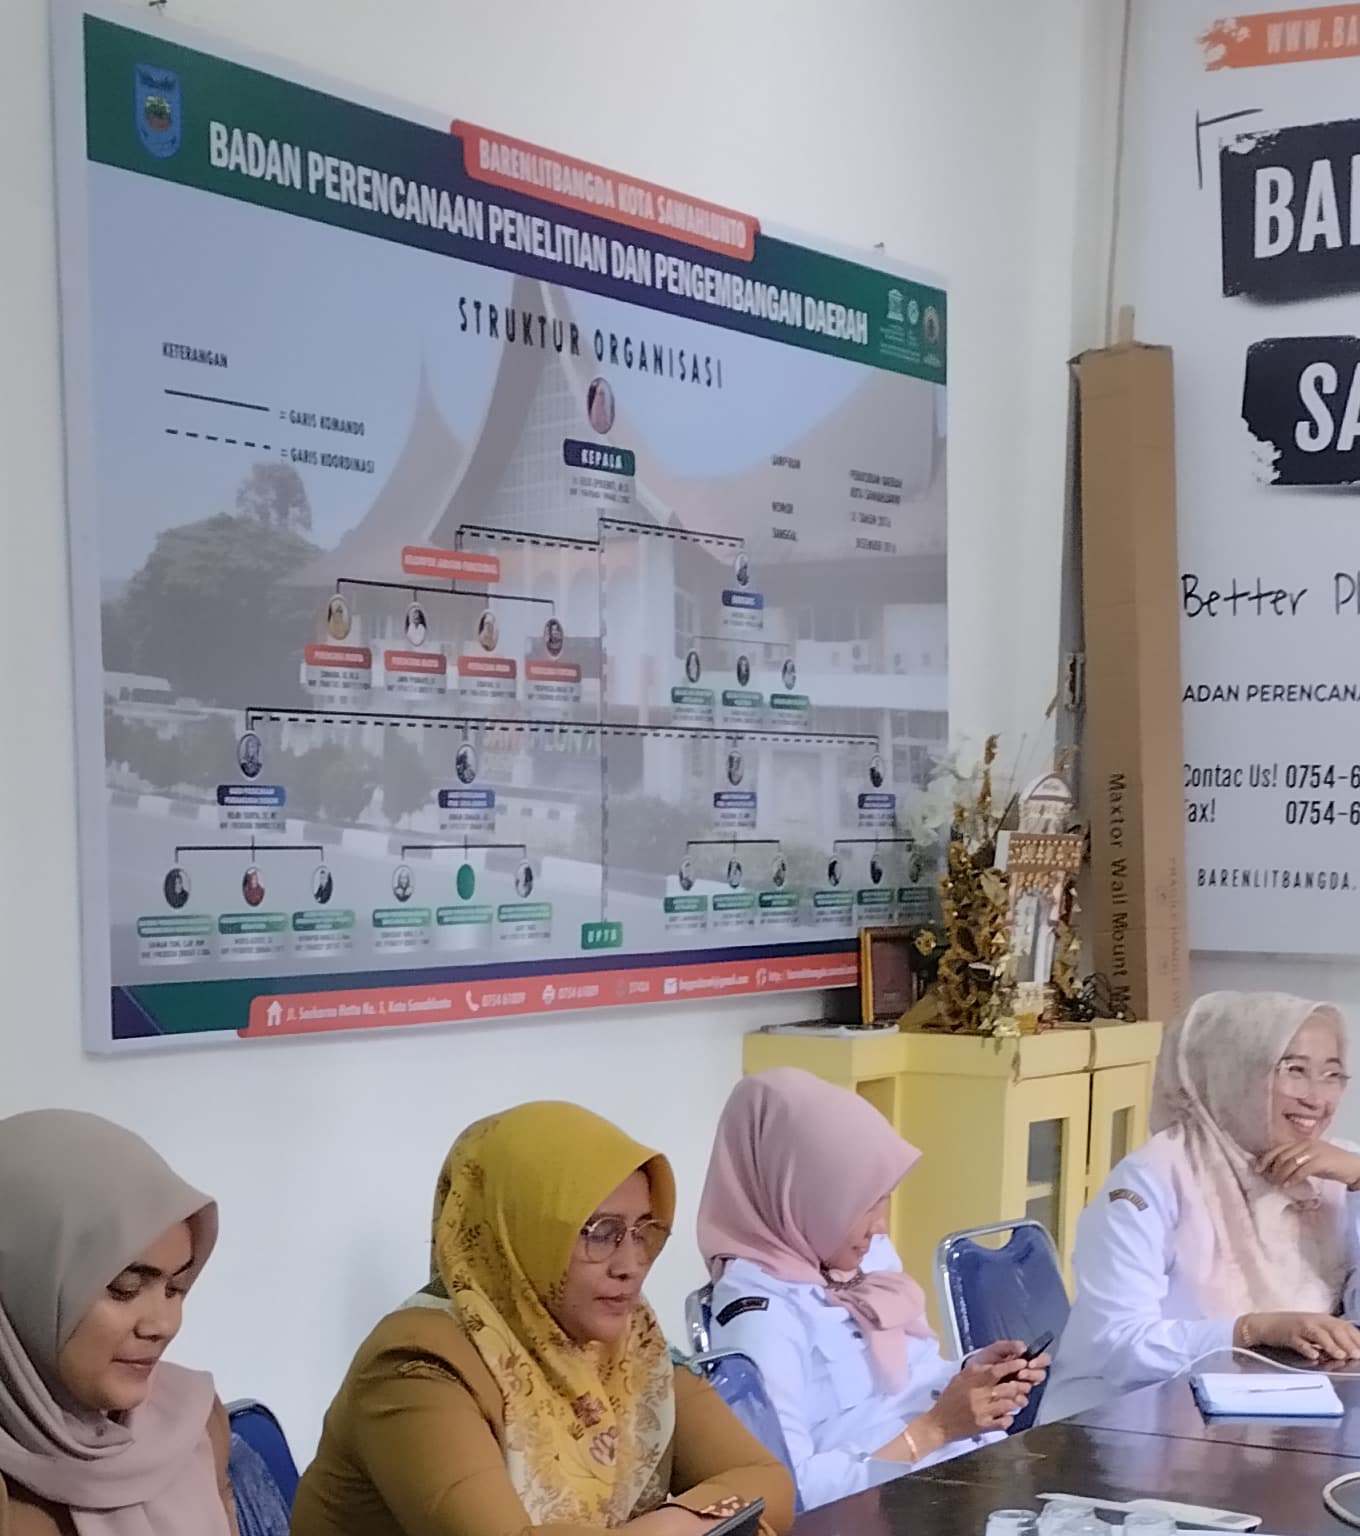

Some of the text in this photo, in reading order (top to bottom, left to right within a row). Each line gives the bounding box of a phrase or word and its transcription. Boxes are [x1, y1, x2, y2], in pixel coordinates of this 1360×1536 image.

[479, 138, 747, 249] BARENLITBANGDA KOTA SAWAHLUNTO
[209, 120, 302, 189] BADAN
[308, 151, 484, 241] PERENCANAAN
[489, 204, 608, 275] PENELITIAN
[611, 239, 652, 287] DAN
[654, 252, 803, 328] PENGEMBANGAN
[804, 296, 868, 345] DAERAH
[162, 342, 228, 368] KETERANGAN
[459, 297, 722, 389] STRUKTUR ORGANISASI
[289, 409, 317, 426] GARIS
[320, 414, 365, 436] KOMANDO
[290, 447, 318, 466] GARIS
[320, 451, 375, 474] KOORDINASI
[581, 449, 623, 470] KEPALA
[1181, 573, 1308, 617] Better
[1249, 763, 1278, 788] Us!
[1108, 773, 1126, 849] Maxtor
[1184, 797, 1215, 823] ax!
[1111, 858, 1128, 904] Wall
[1111, 912, 1129, 976] Mount
